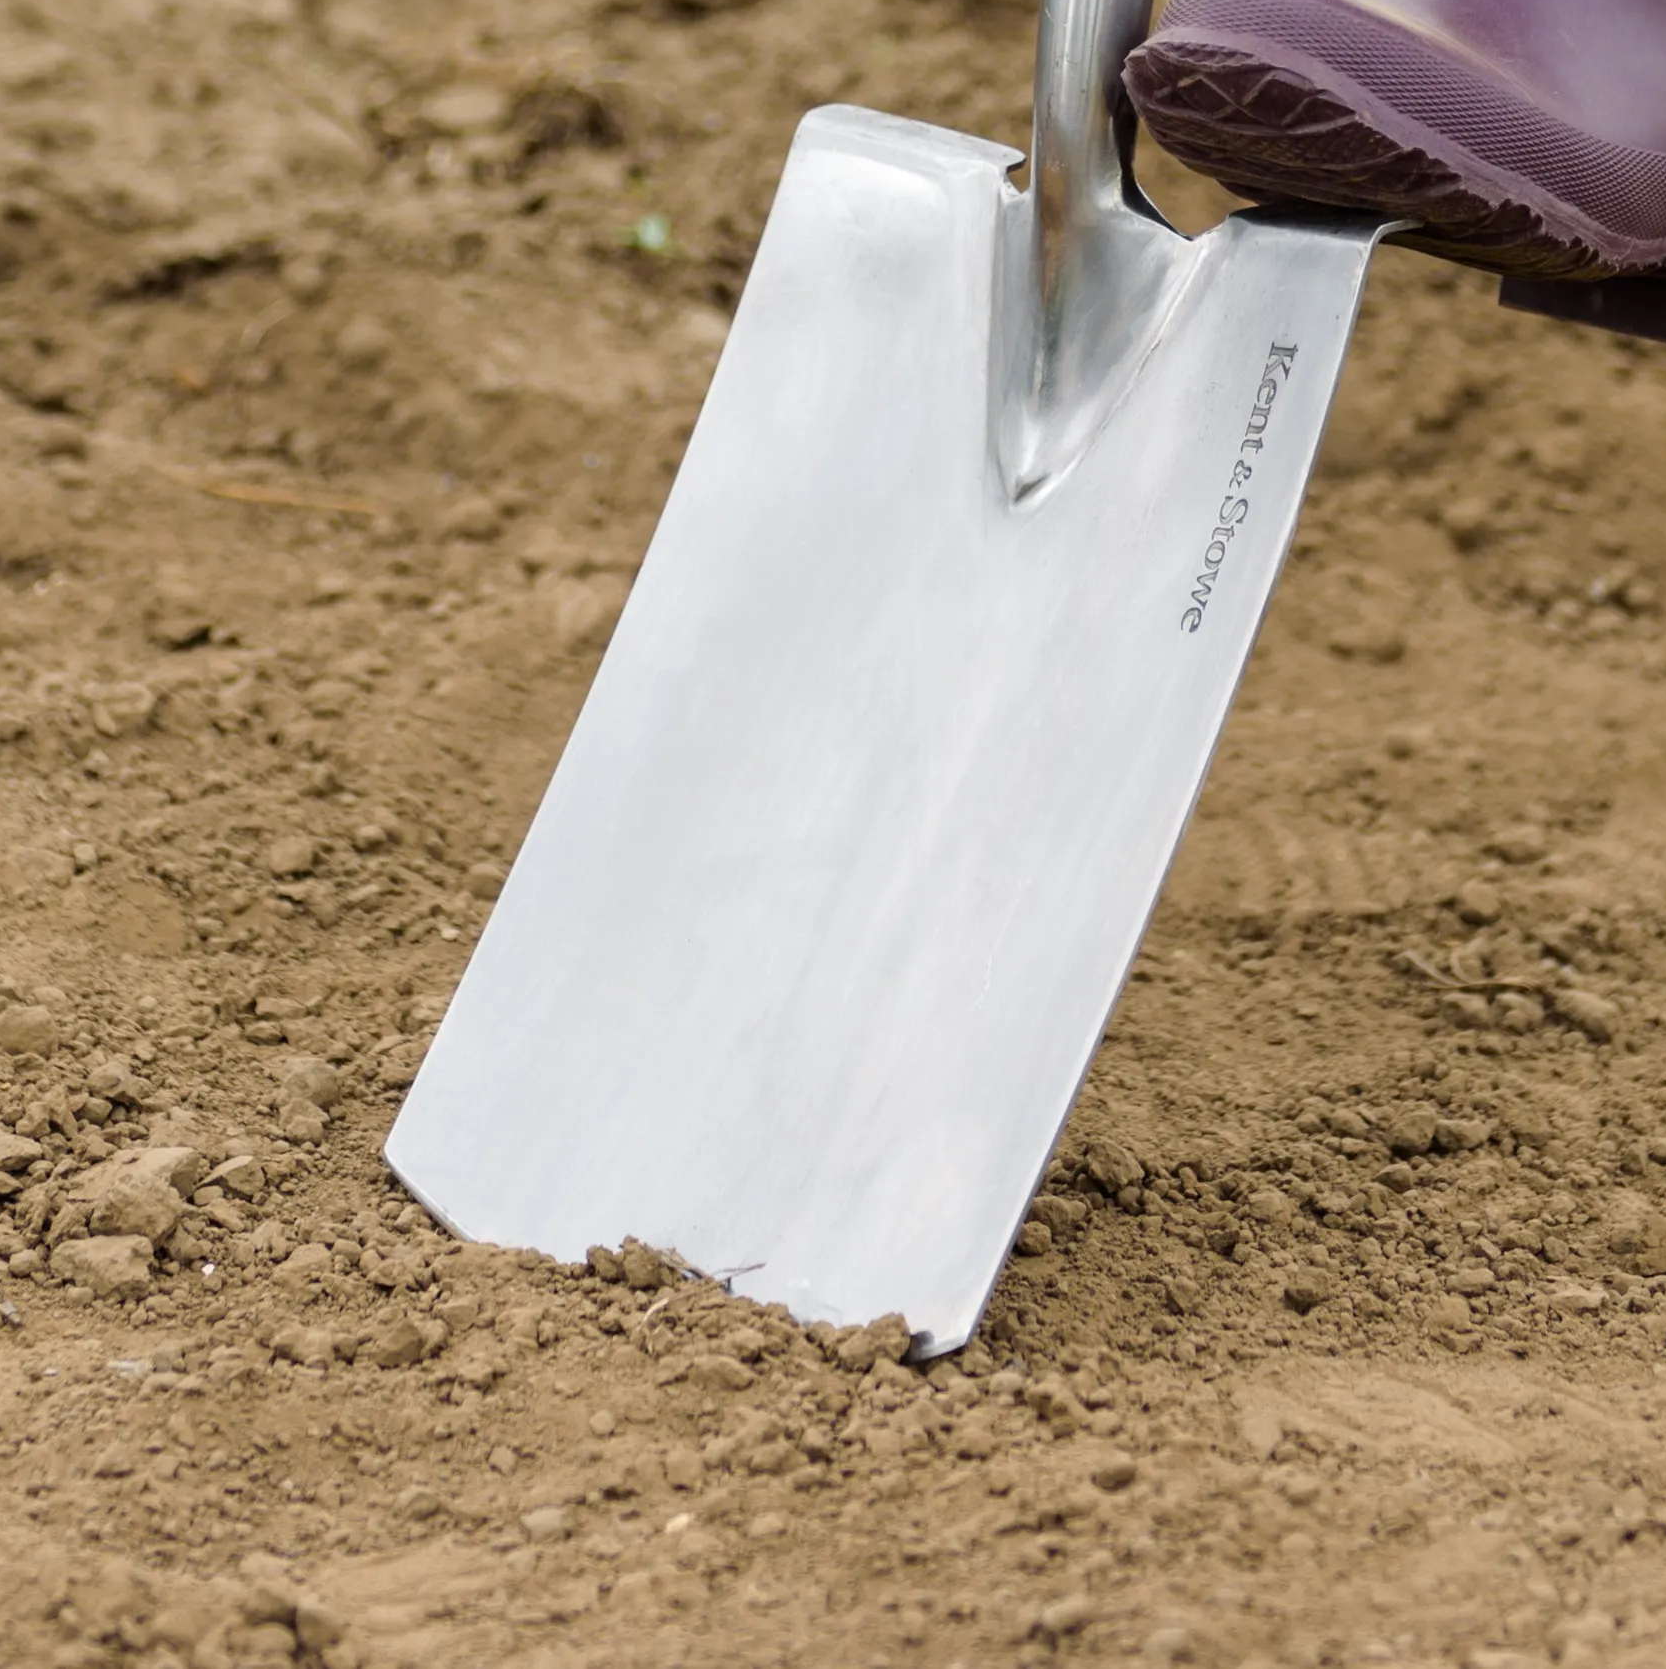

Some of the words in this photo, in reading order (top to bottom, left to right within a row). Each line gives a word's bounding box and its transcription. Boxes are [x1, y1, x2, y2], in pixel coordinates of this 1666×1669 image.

[1240, 341, 1299, 454] Kent
[1229, 459, 1252, 488] &
[1180, 495, 1249, 633] Stowe
